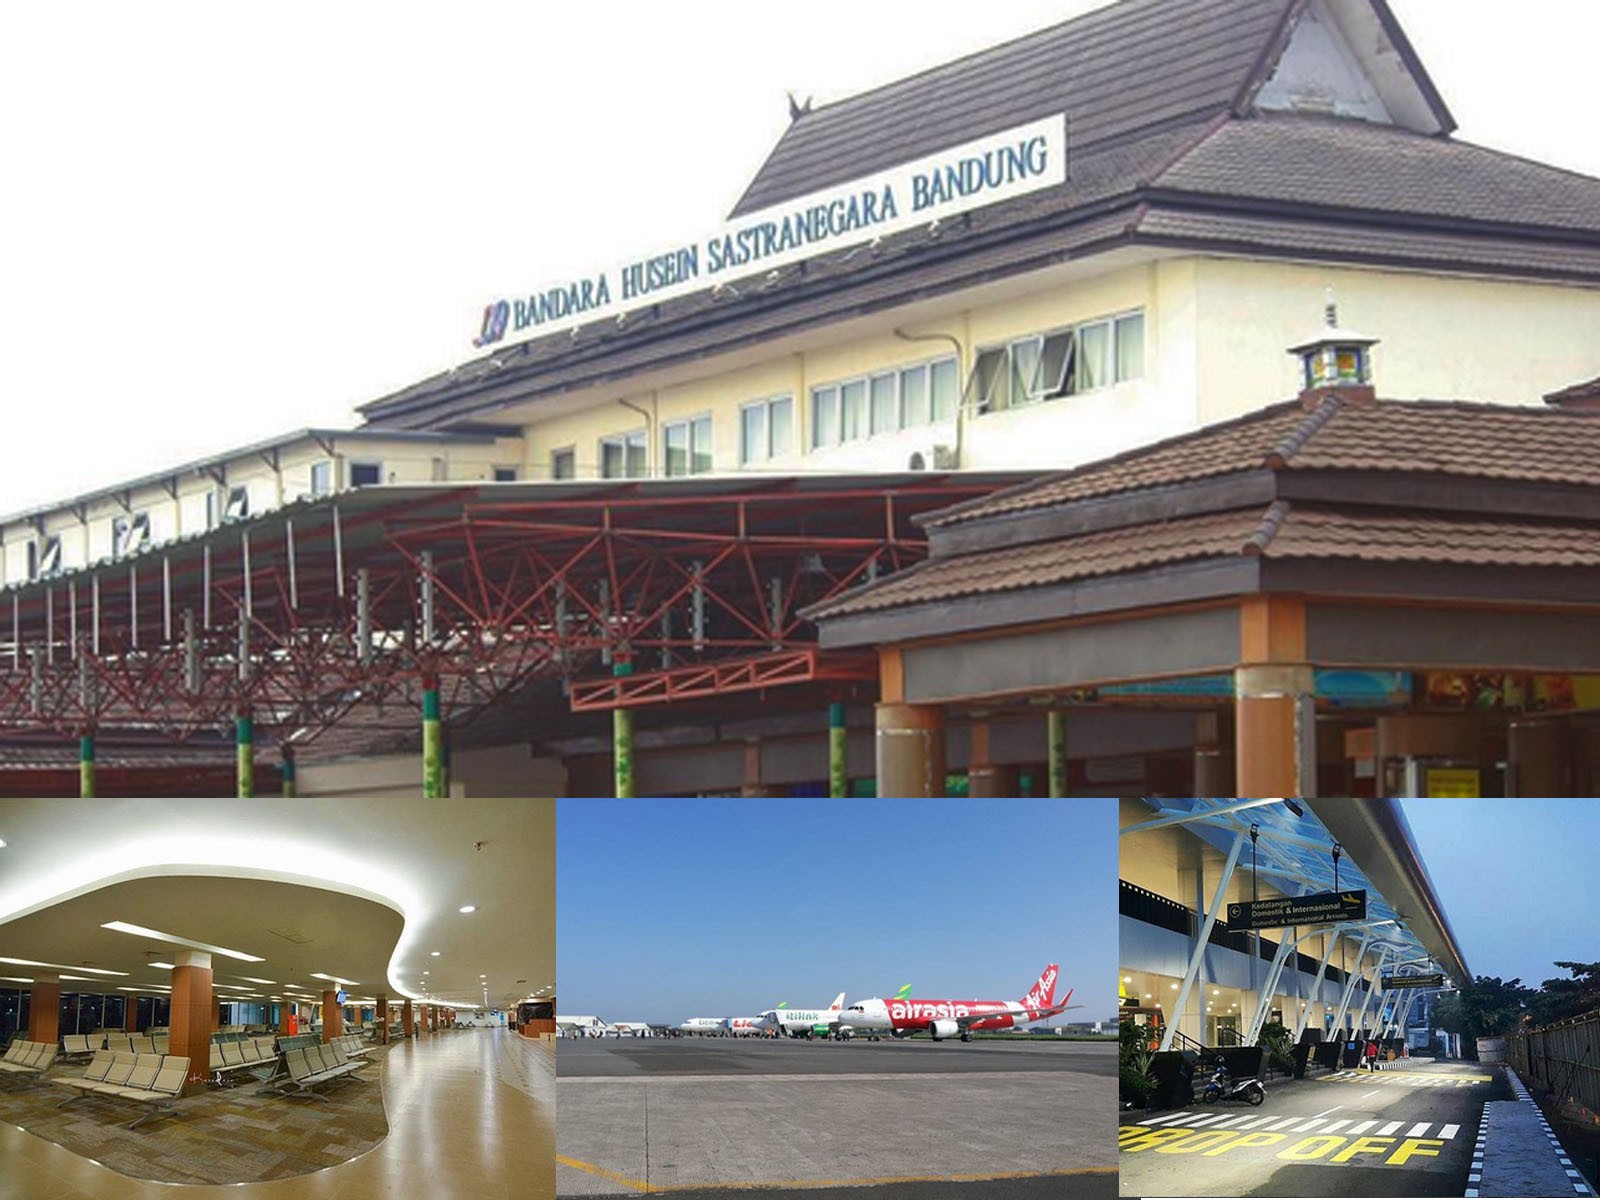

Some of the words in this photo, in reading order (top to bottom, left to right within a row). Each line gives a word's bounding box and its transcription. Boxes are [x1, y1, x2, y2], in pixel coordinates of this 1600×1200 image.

[513, 273, 611, 331] BANDARA
[621, 244, 699, 300] HUSEIN
[707, 184, 898, 274] SASTRANEGARA
[911, 135, 1048, 213] BANDUNG
[1251, 900, 1293, 910] Kedatangan
[1251, 908, 1284, 918] Domestik
[1285, 906, 1292, 915] &
[1292, 902, 1341, 914] Internasional
[1251, 919, 1278, 927] Domestic
[1287, 914, 1325, 924] International
[785, 1011, 820, 1021] itilink
[891, 1000, 970, 1020] airasia
[1275, 1135, 1445, 1165] OFF
